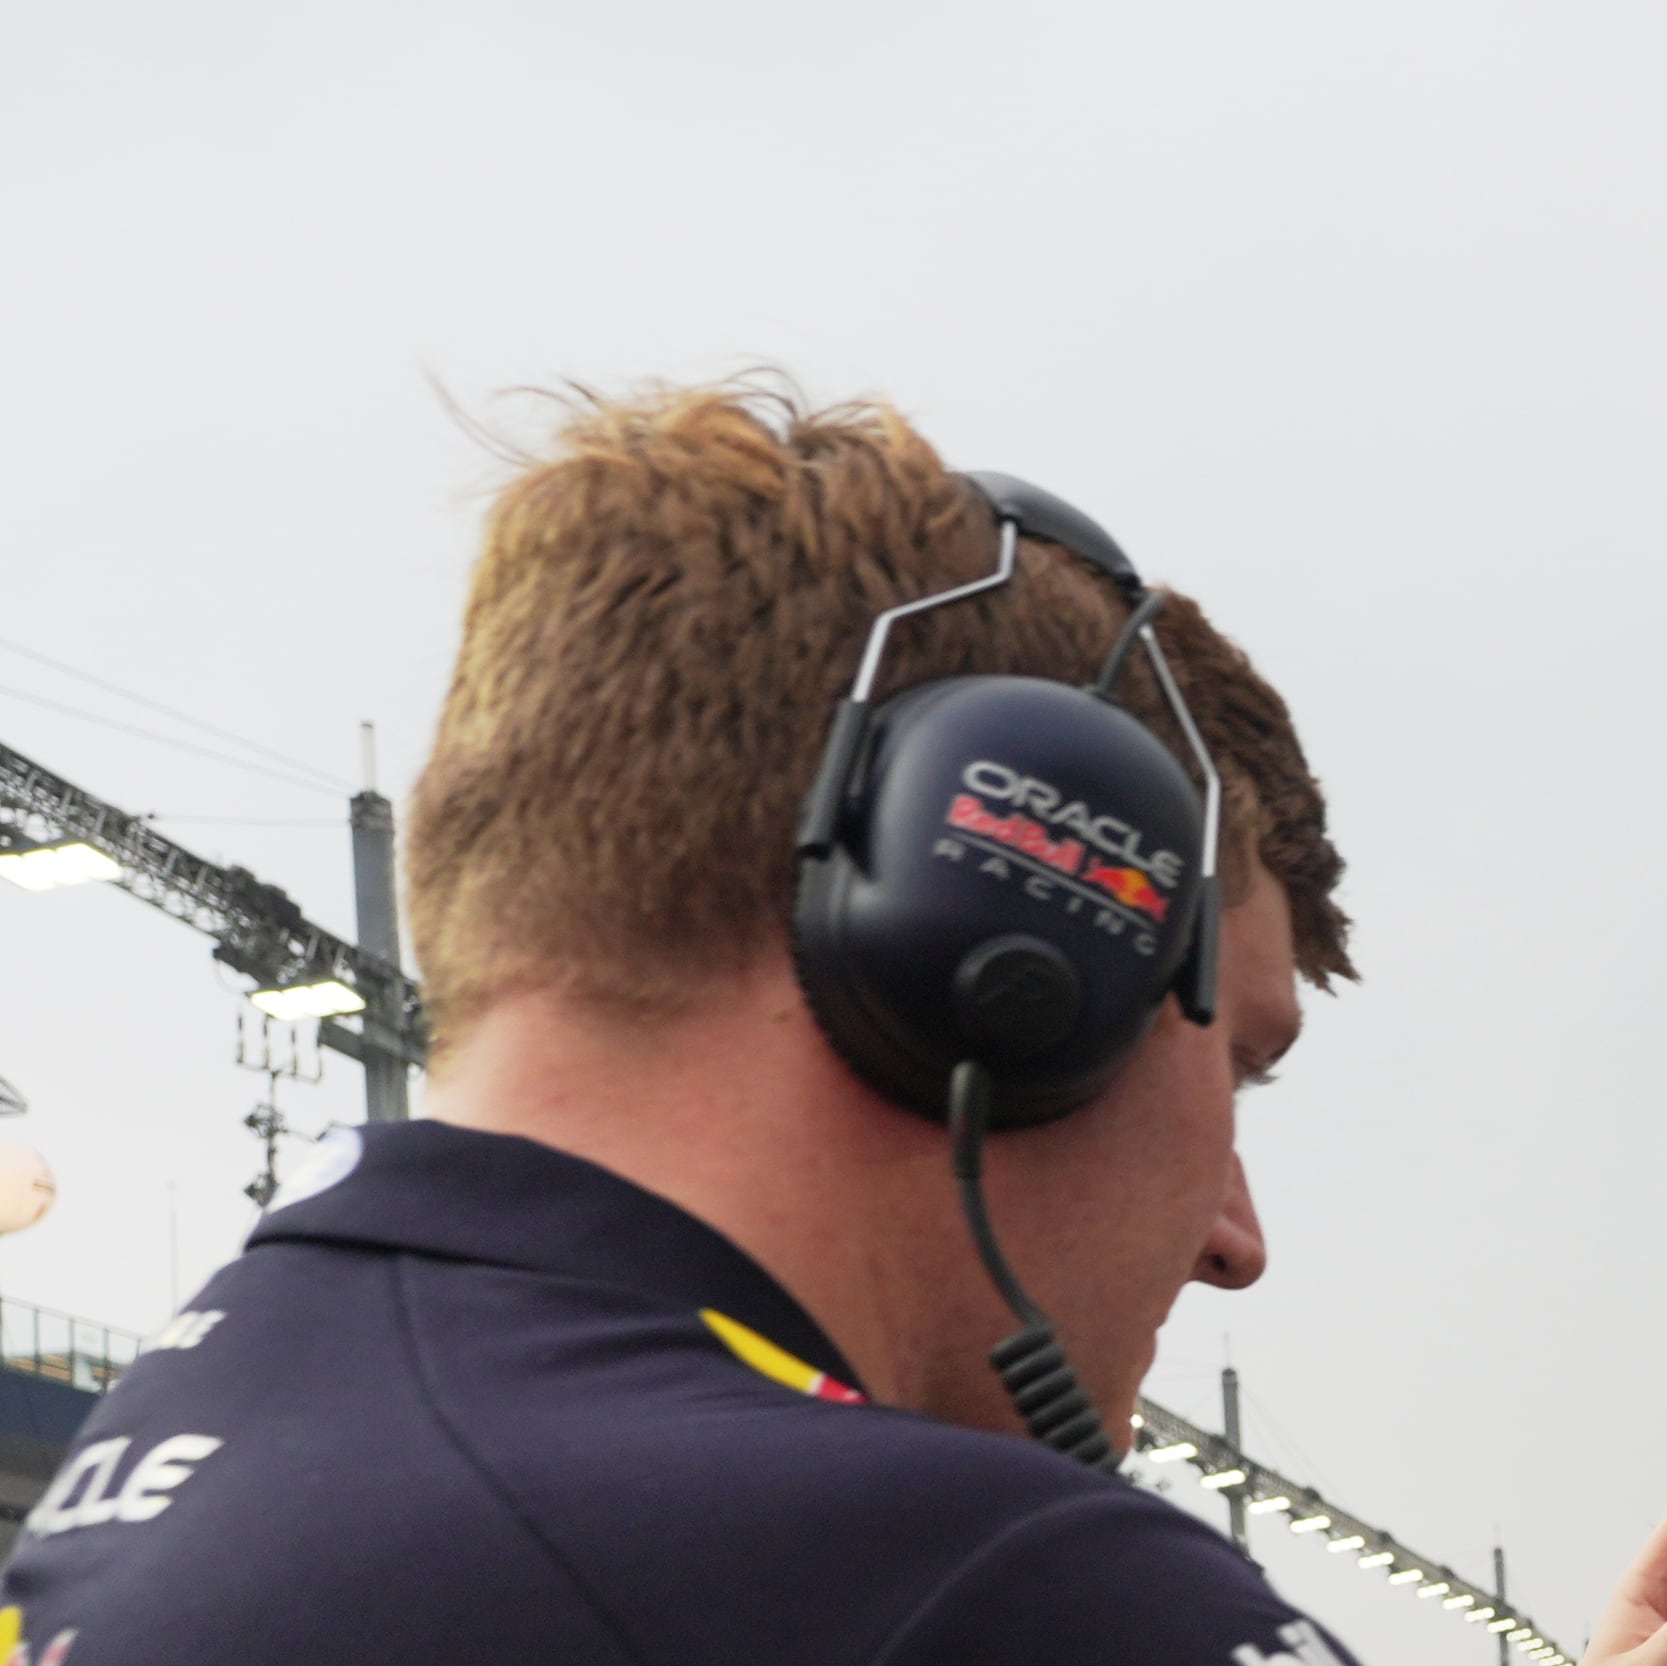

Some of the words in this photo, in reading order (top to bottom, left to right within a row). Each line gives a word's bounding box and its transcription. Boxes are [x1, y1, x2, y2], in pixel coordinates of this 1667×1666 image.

[962, 760, 1185, 889] ORACLE
[933, 838, 1156, 955] RACING
[27, 1434, 226, 1538] CLE
